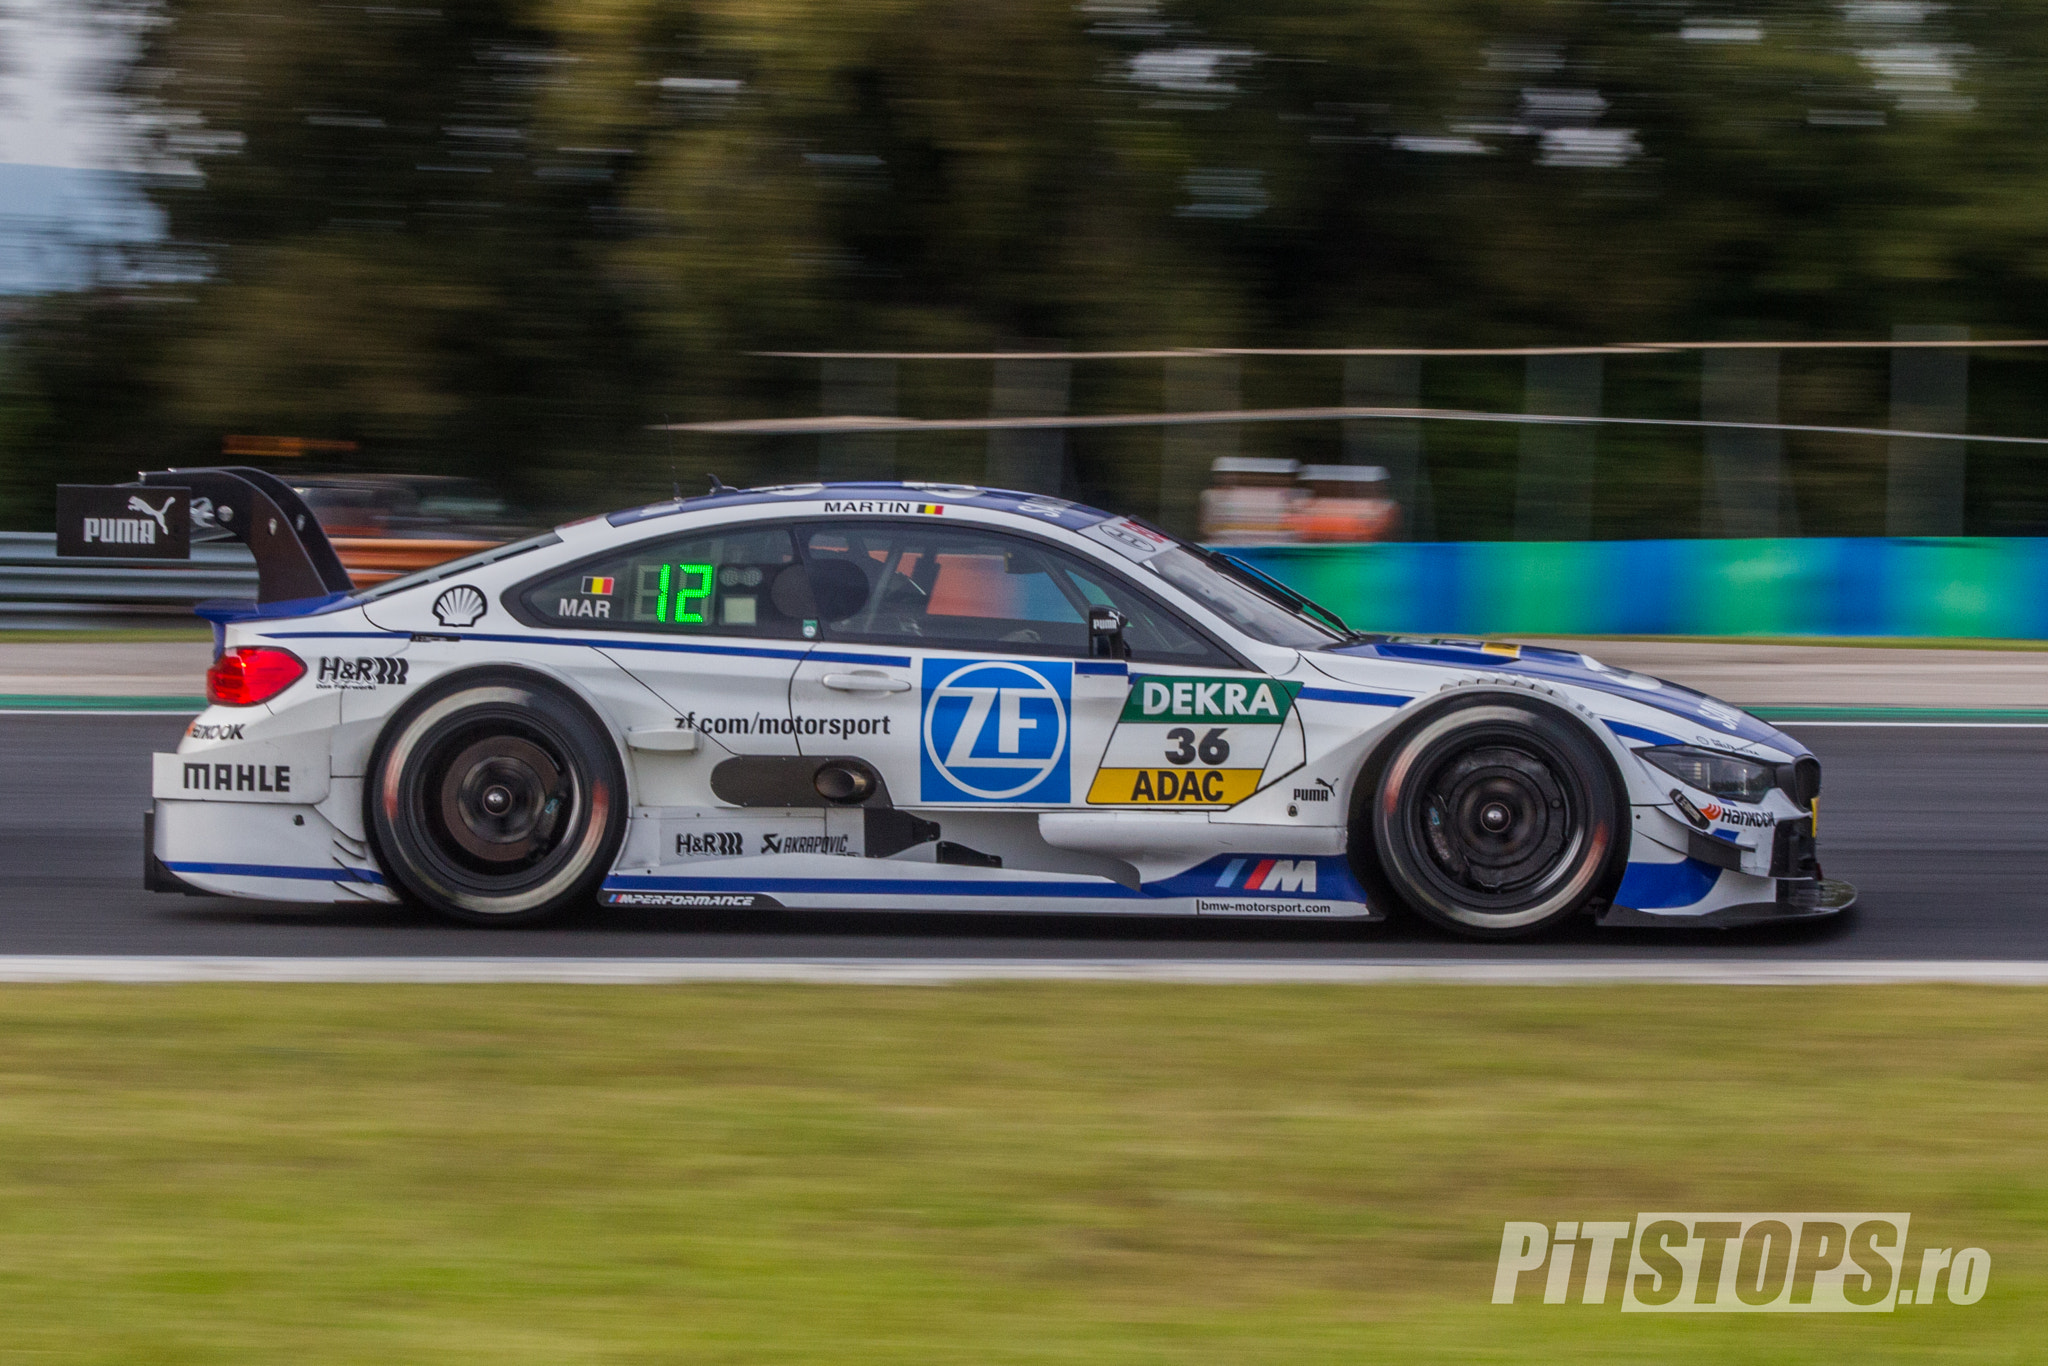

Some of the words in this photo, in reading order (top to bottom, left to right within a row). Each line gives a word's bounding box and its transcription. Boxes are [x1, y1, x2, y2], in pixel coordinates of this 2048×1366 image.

[823, 501, 910, 514] MARTIN
[83, 517, 156, 545] PUMA
[655, 562, 714, 624] 12
[558, 598, 610, 618] MAR
[317, 656, 377, 684] H&R
[1142, 681, 1280, 716] DEKRA
[674, 711, 891, 740] zf.com/motorsport
[936, 686, 1053, 769] ZF
[1164, 727, 1230, 766] 36
[183, 762, 290, 793] MAHLE
[1130, 769, 1224, 803] ADAC
[1293, 788, 1329, 802] PUMA
[676, 832, 719, 855] H&R
[1257, 859, 1317, 893] M
[1200, 900, 1331, 914] bmw-motorsport.com
